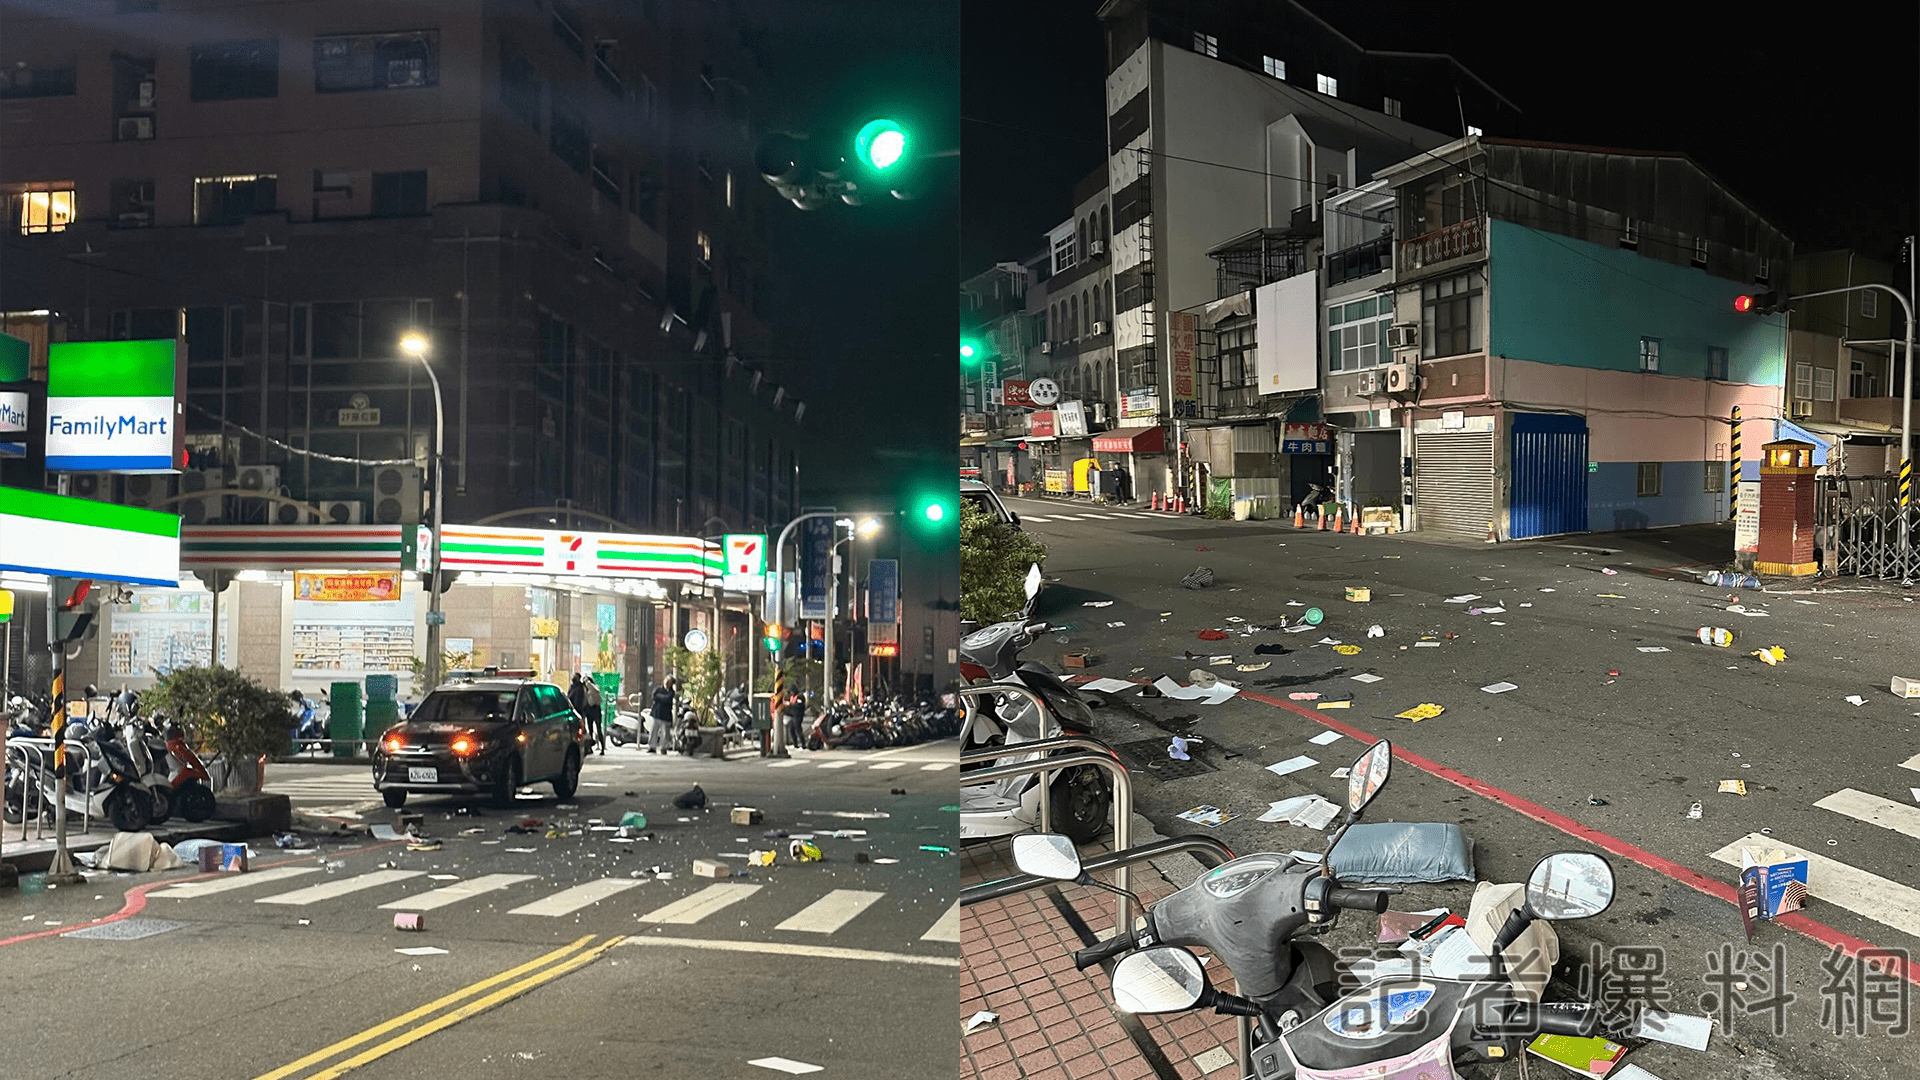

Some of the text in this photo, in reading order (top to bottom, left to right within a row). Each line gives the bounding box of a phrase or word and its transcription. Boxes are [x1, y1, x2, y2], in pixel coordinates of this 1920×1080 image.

[1174, 350, 1193, 396] 意麵
[0, 404, 25, 427] Mart
[1173, 399, 1196, 417] 炒飯
[50, 415, 167, 440] FamilyMart
[1287, 441, 1326, 452] 牛肉麵
